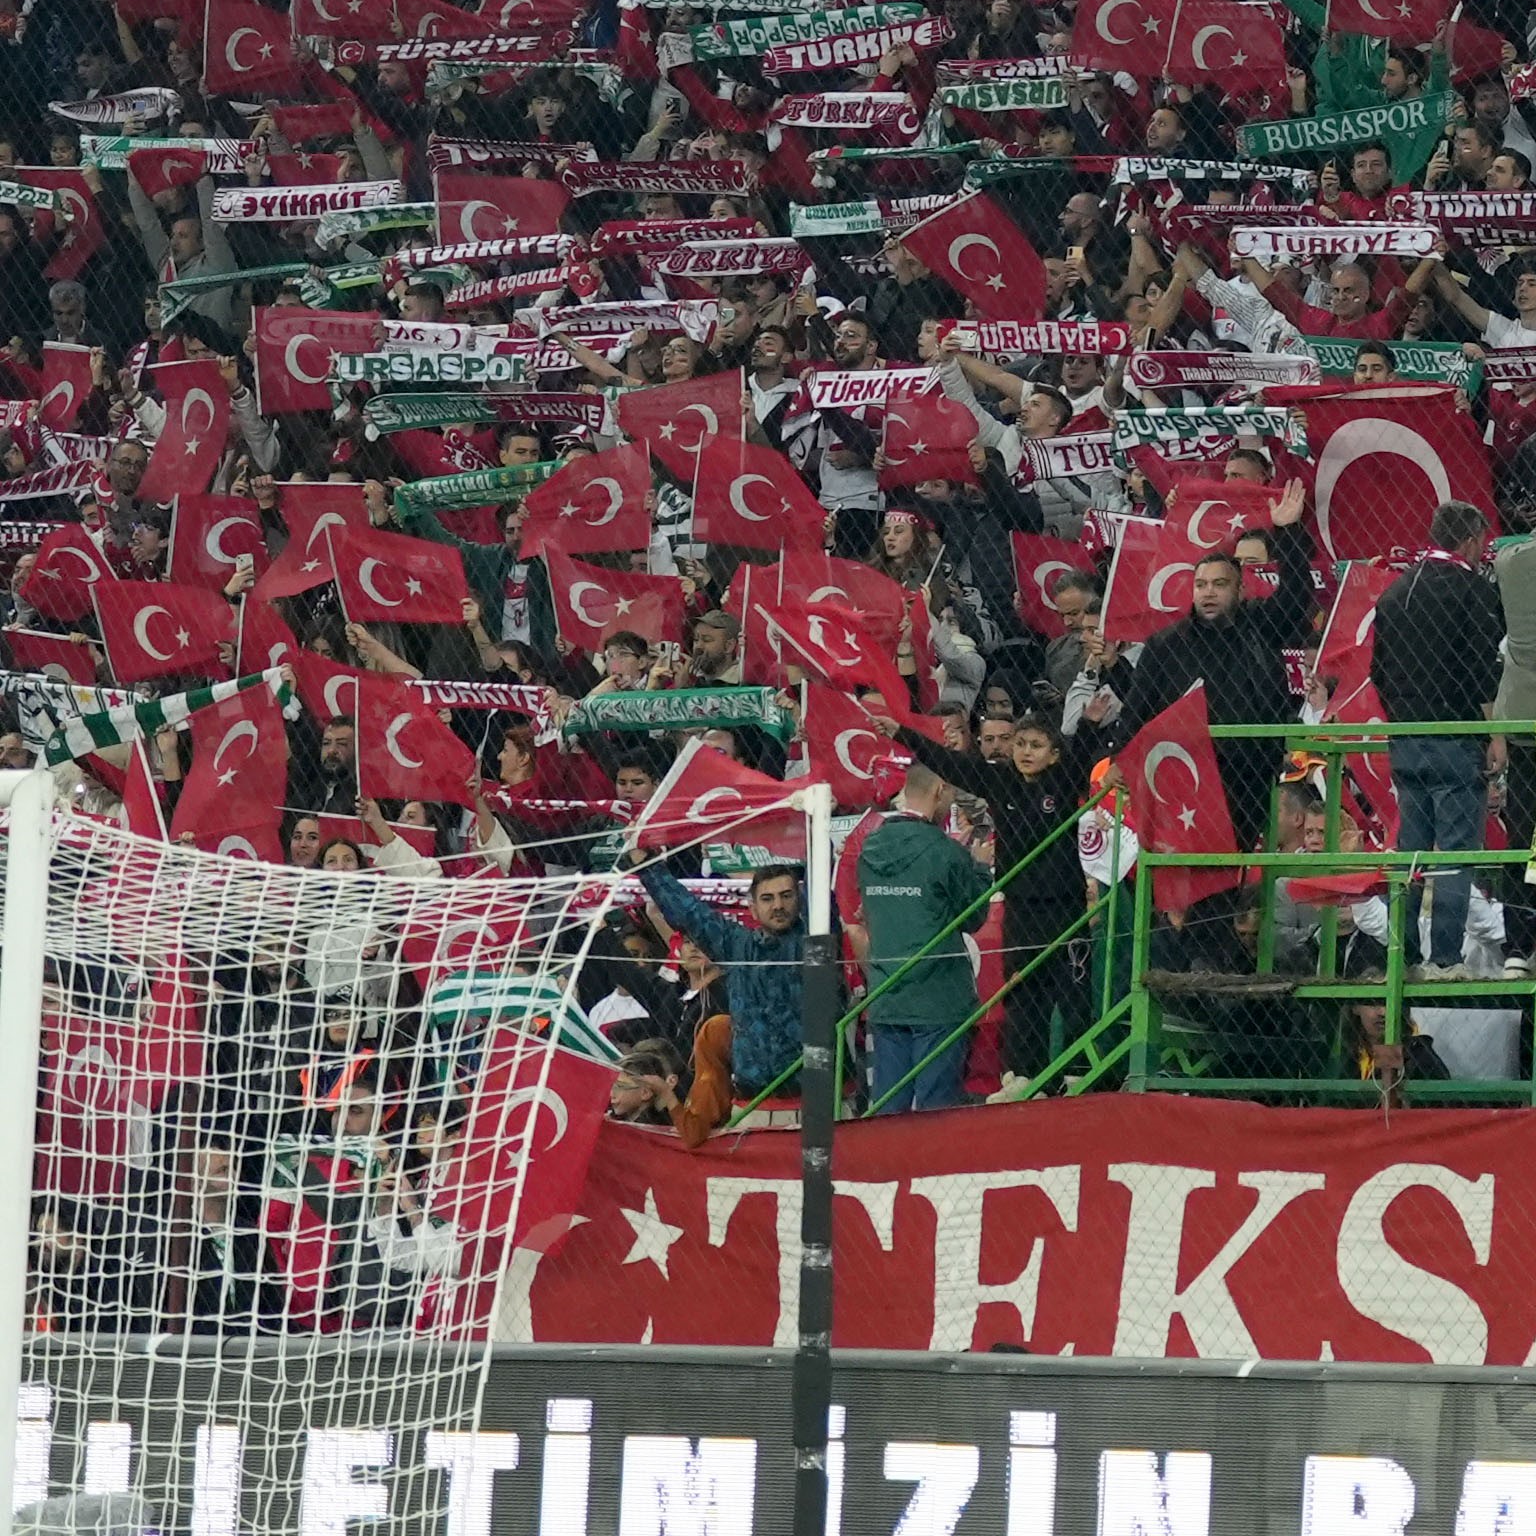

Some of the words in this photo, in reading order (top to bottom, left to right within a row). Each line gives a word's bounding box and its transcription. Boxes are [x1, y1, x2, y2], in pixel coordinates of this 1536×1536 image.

[375, 35, 542, 59] TÜRKİYE
[788, 96, 901, 124] TÜRKİYE
[1266, 100, 1426, 152] BURSASPOR
[1272, 232, 1396, 253] TÜRKİYE
[816, 370, 924, 406] TÜRKİYE
[1116, 409, 1285, 436] BURSASPOR
[422, 680, 542, 708] TÜRKİYE
